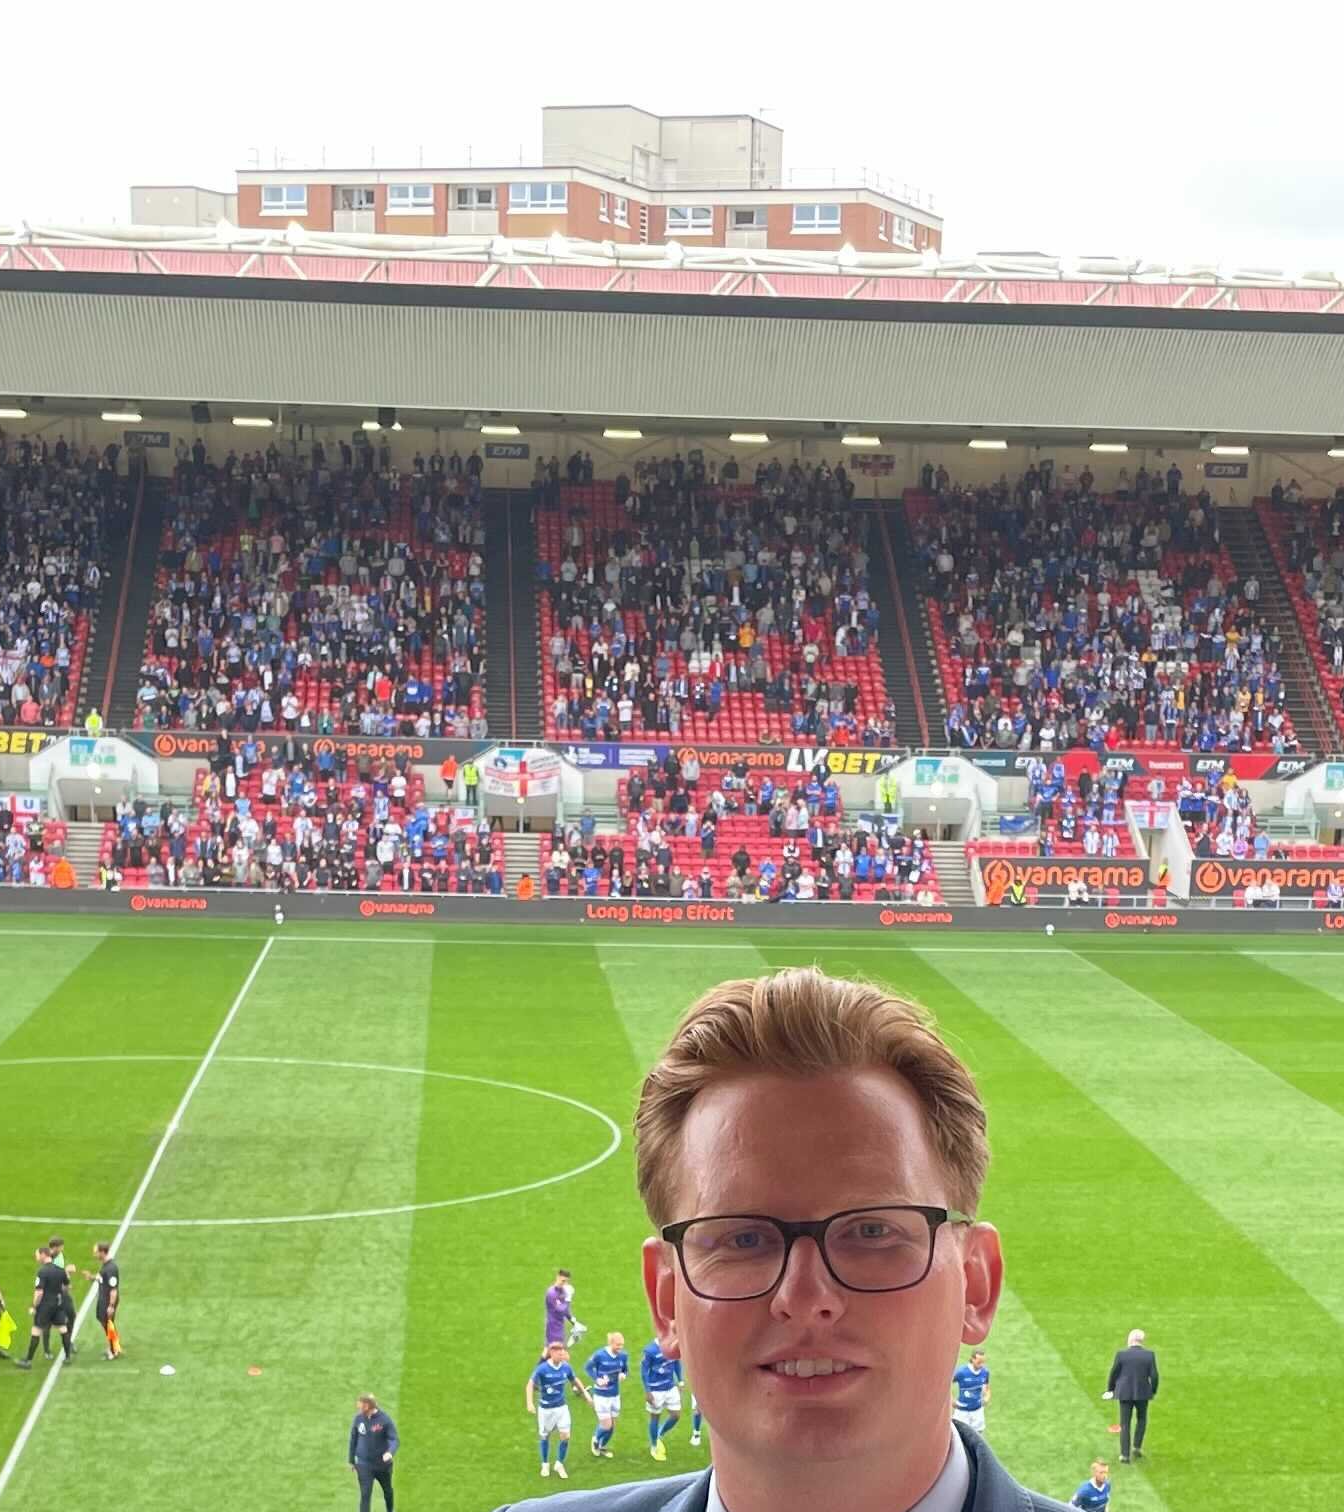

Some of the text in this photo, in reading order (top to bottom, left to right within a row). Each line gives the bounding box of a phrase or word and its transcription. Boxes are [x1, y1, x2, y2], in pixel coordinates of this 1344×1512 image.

[145, 897, 207, 910] vanarama
[375, 902, 434, 915] vanarama
[587, 904, 734, 923] Long Range Effort
[895, 911, 953, 923] vanarama
